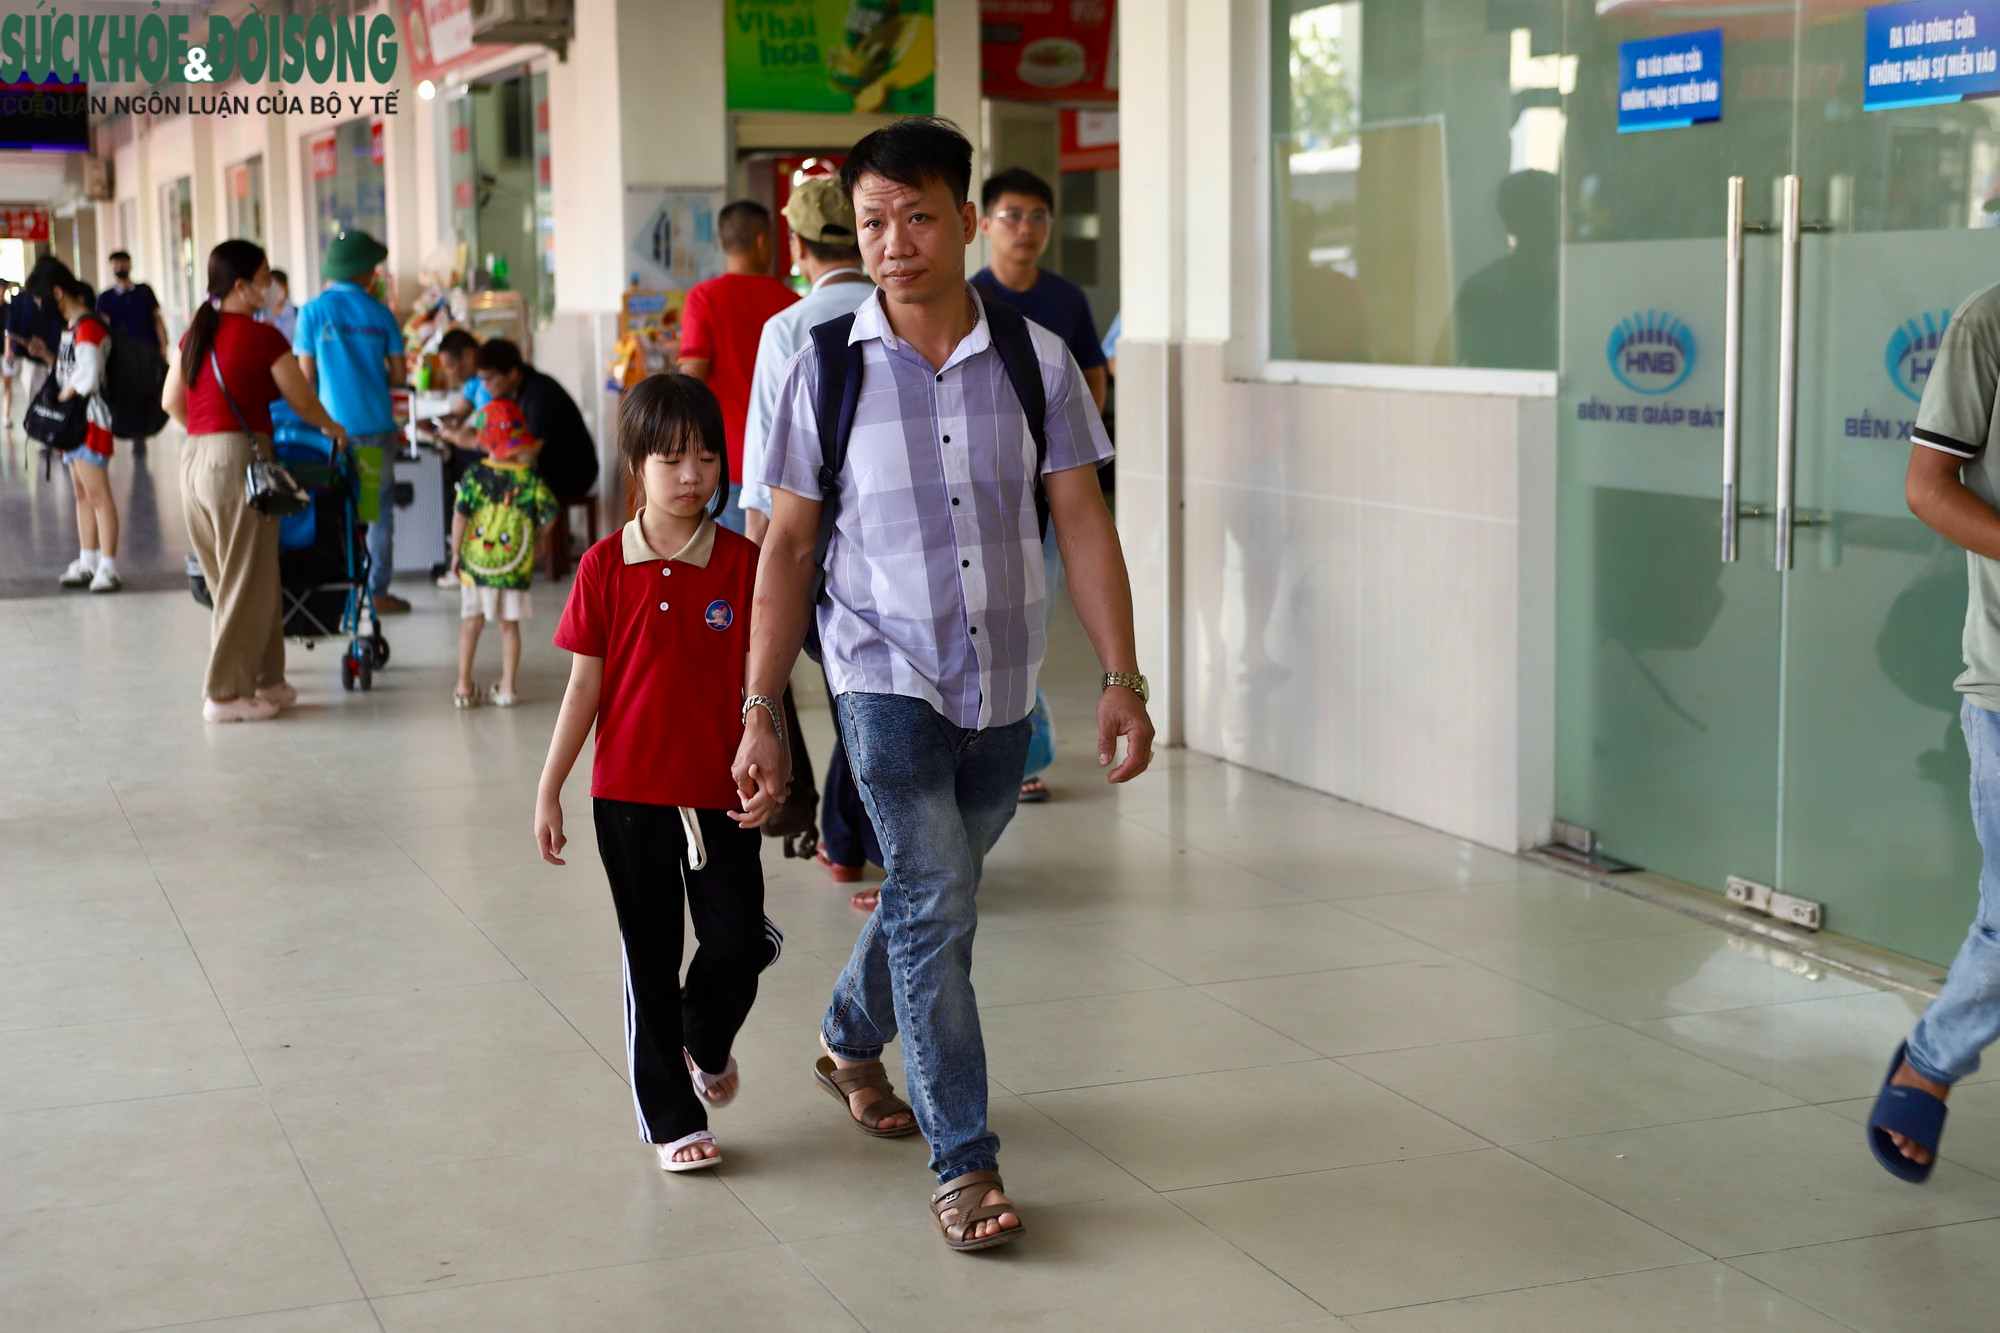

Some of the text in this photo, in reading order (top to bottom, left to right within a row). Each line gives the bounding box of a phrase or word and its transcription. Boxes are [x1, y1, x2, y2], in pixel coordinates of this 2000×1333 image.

[1889, 26, 1903, 48] RA
[1905, 20, 1924, 47] VÀO
[1869, 58, 1902, 86] KHÔNG
[1903, 54, 1931, 86] PHẬN
[1976, 46, 1997, 74] VÀO
[1625, 351, 1676, 375] HNB
[1616, 405, 1638, 423] XE
[1642, 401, 1684, 426] GIÁP
[1845, 407, 1890, 439] BẾN
